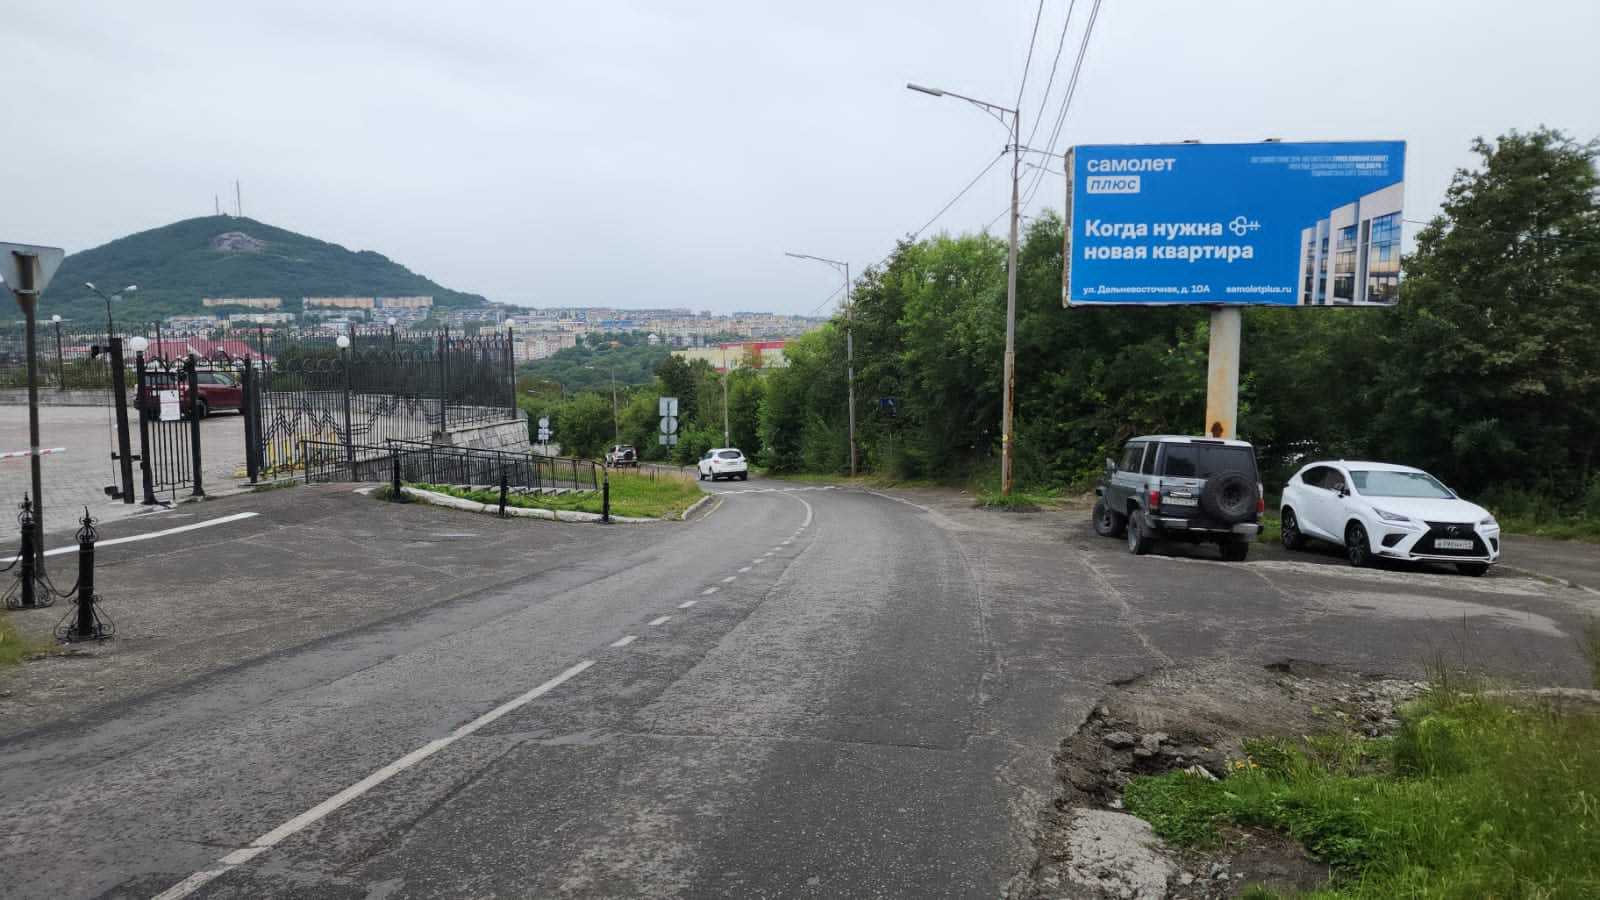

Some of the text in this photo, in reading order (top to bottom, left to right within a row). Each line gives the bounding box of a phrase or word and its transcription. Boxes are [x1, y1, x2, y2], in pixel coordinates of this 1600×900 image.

[1087, 158, 1176, 172] самолет
[1085, 219, 1223, 240] Когда нужна
[1084, 245, 1254, 263] новая квартира
